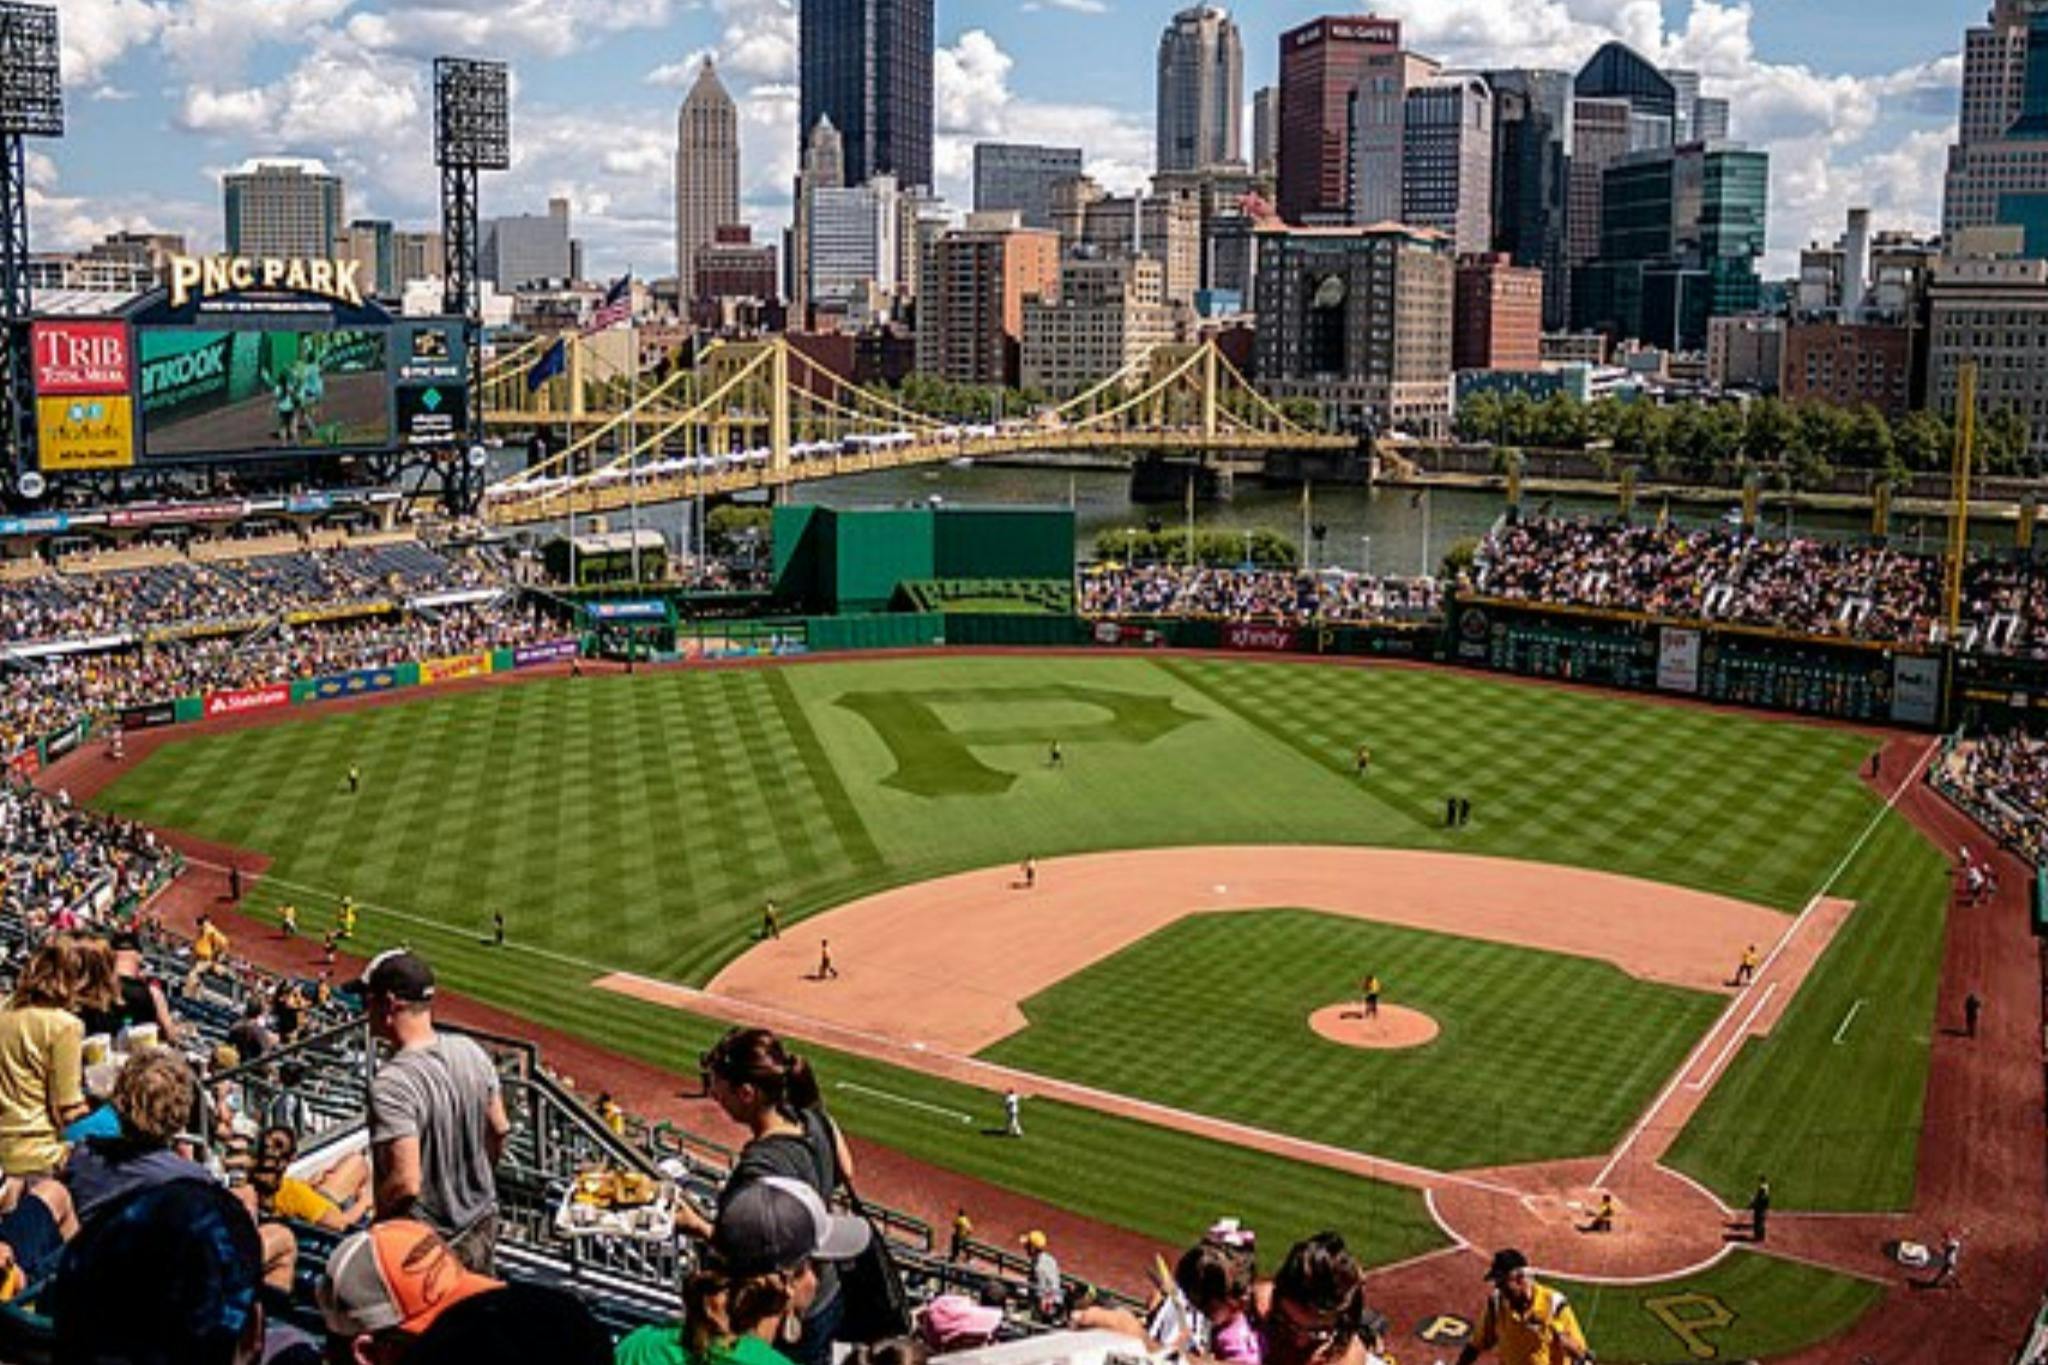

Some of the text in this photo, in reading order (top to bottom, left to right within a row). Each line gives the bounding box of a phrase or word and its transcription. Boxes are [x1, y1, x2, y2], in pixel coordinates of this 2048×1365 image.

[168, 252, 364, 308] PNC PARK
[38, 330, 123, 366] TRIB
[1421, 1315, 1469, 1340] P
[1641, 1291, 1740, 1358] P
